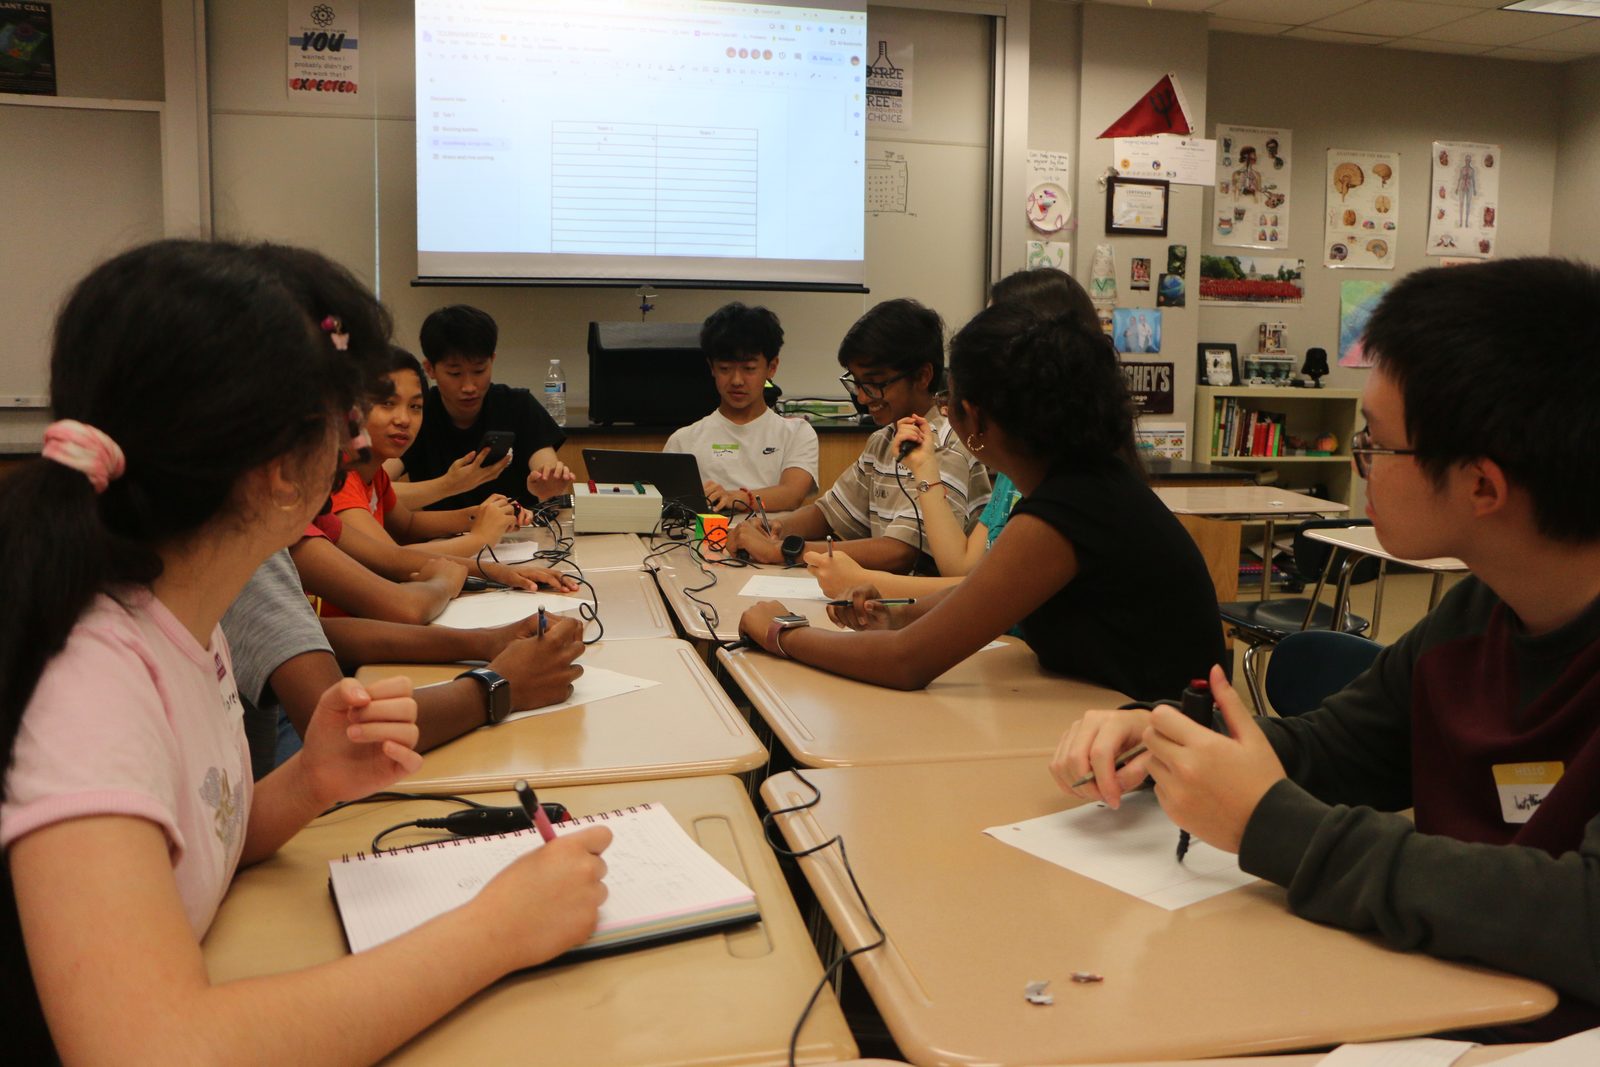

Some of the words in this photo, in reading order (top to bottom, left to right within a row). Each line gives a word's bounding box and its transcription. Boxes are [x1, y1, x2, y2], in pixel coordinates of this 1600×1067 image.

[0, 2, 21, 10] LANT
[24, 4, 46, 13] CELL
[302, 31, 344, 52] YOU
[874, 67, 903, 79] FREE
[292, 78, 357, 94] EXPECTED.
[868, 78, 903, 88] CHOOSE
[866, 95, 890, 107] REE
[868, 112, 902, 123] CHOICE
[1119, 365, 1170, 392] SHEY'S
[1514, 765, 1545, 775] HELLO
